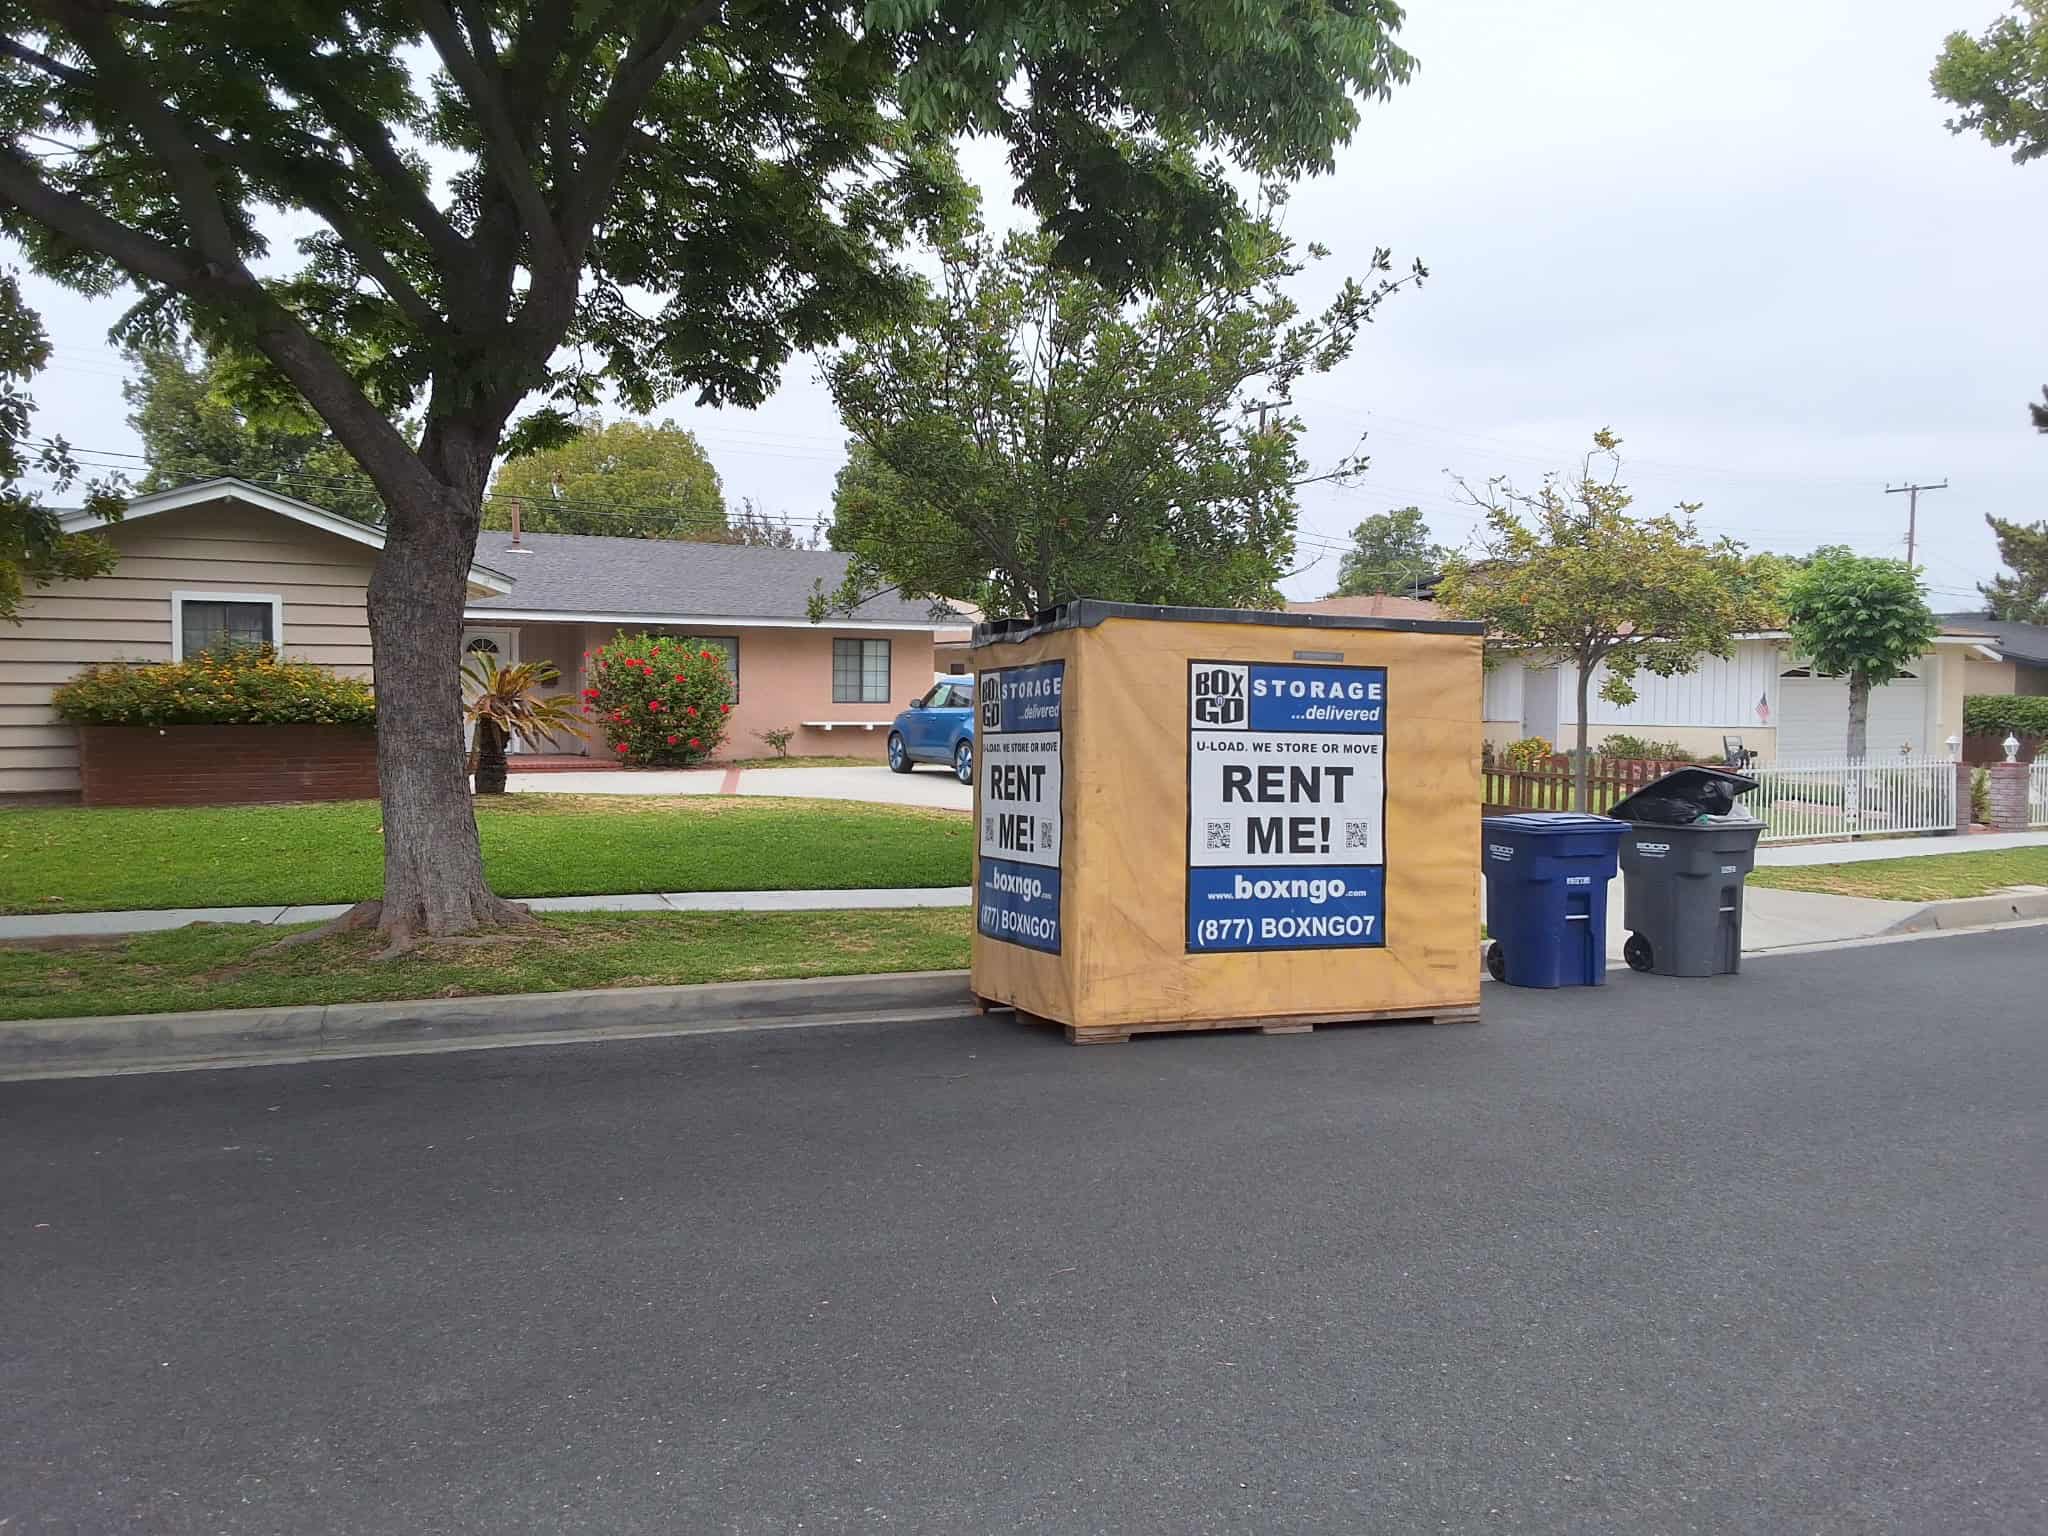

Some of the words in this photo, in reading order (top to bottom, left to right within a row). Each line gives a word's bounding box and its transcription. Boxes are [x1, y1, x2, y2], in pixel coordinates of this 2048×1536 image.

[1001, 677, 1061, 700] STORAGE
[1195, 669, 1244, 697] BOX
[1253, 679, 1382, 700] STORAGE
[1195, 697, 1244, 724] GO
[1291, 704, 1381, 721] ...delivered
[1011, 743, 1029, 753] STORE
[1030, 742, 1039, 753] OR
[1040, 741, 1058, 753] MOVE
[1196, 740, 1248, 752] U-LOAD.
[1252, 742, 1272, 753] WE
[1276, 742, 1318, 753] STORE
[1322, 743, 1339, 754] OR
[1343, 743, 1379, 755] MOVE
[991, 764, 1046, 802] RENT
[1222, 764, 1354, 803] RENT
[999, 813, 1035, 853] ME!
[1247, 816, 1331, 854] ME!
[1207, 874, 1367, 904] www.boxngo.com
[1001, 909, 1056, 941] BOXNGO7
[1197, 918, 1254, 946] (877)
[1261, 915, 1376, 939] BOXNGO7
